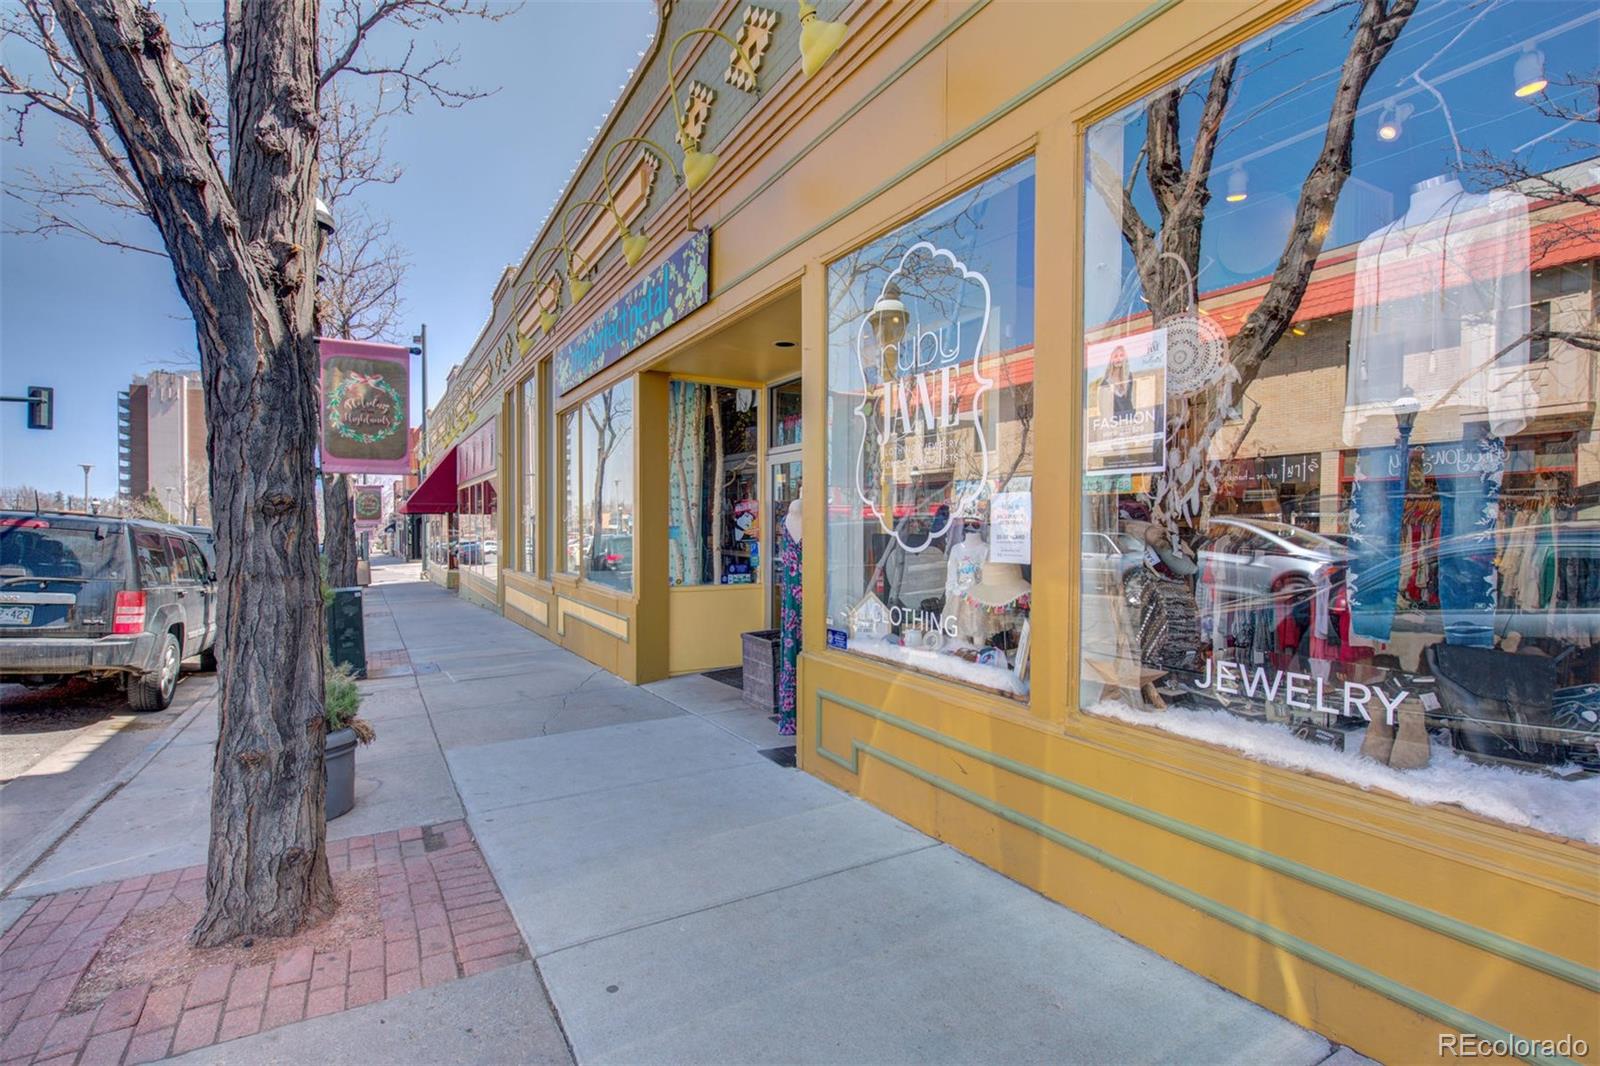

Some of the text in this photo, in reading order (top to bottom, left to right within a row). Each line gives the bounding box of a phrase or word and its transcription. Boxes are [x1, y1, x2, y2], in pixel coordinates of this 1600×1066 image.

[629, 261, 669, 348] petal
[881, 321, 960, 377] ruby
[873, 364, 960, 445] JANE
[1093, 407, 1155, 431] FASHION
[873, 603, 958, 637] CLOTHING
[1194, 658, 1409, 726] JEWELRY
